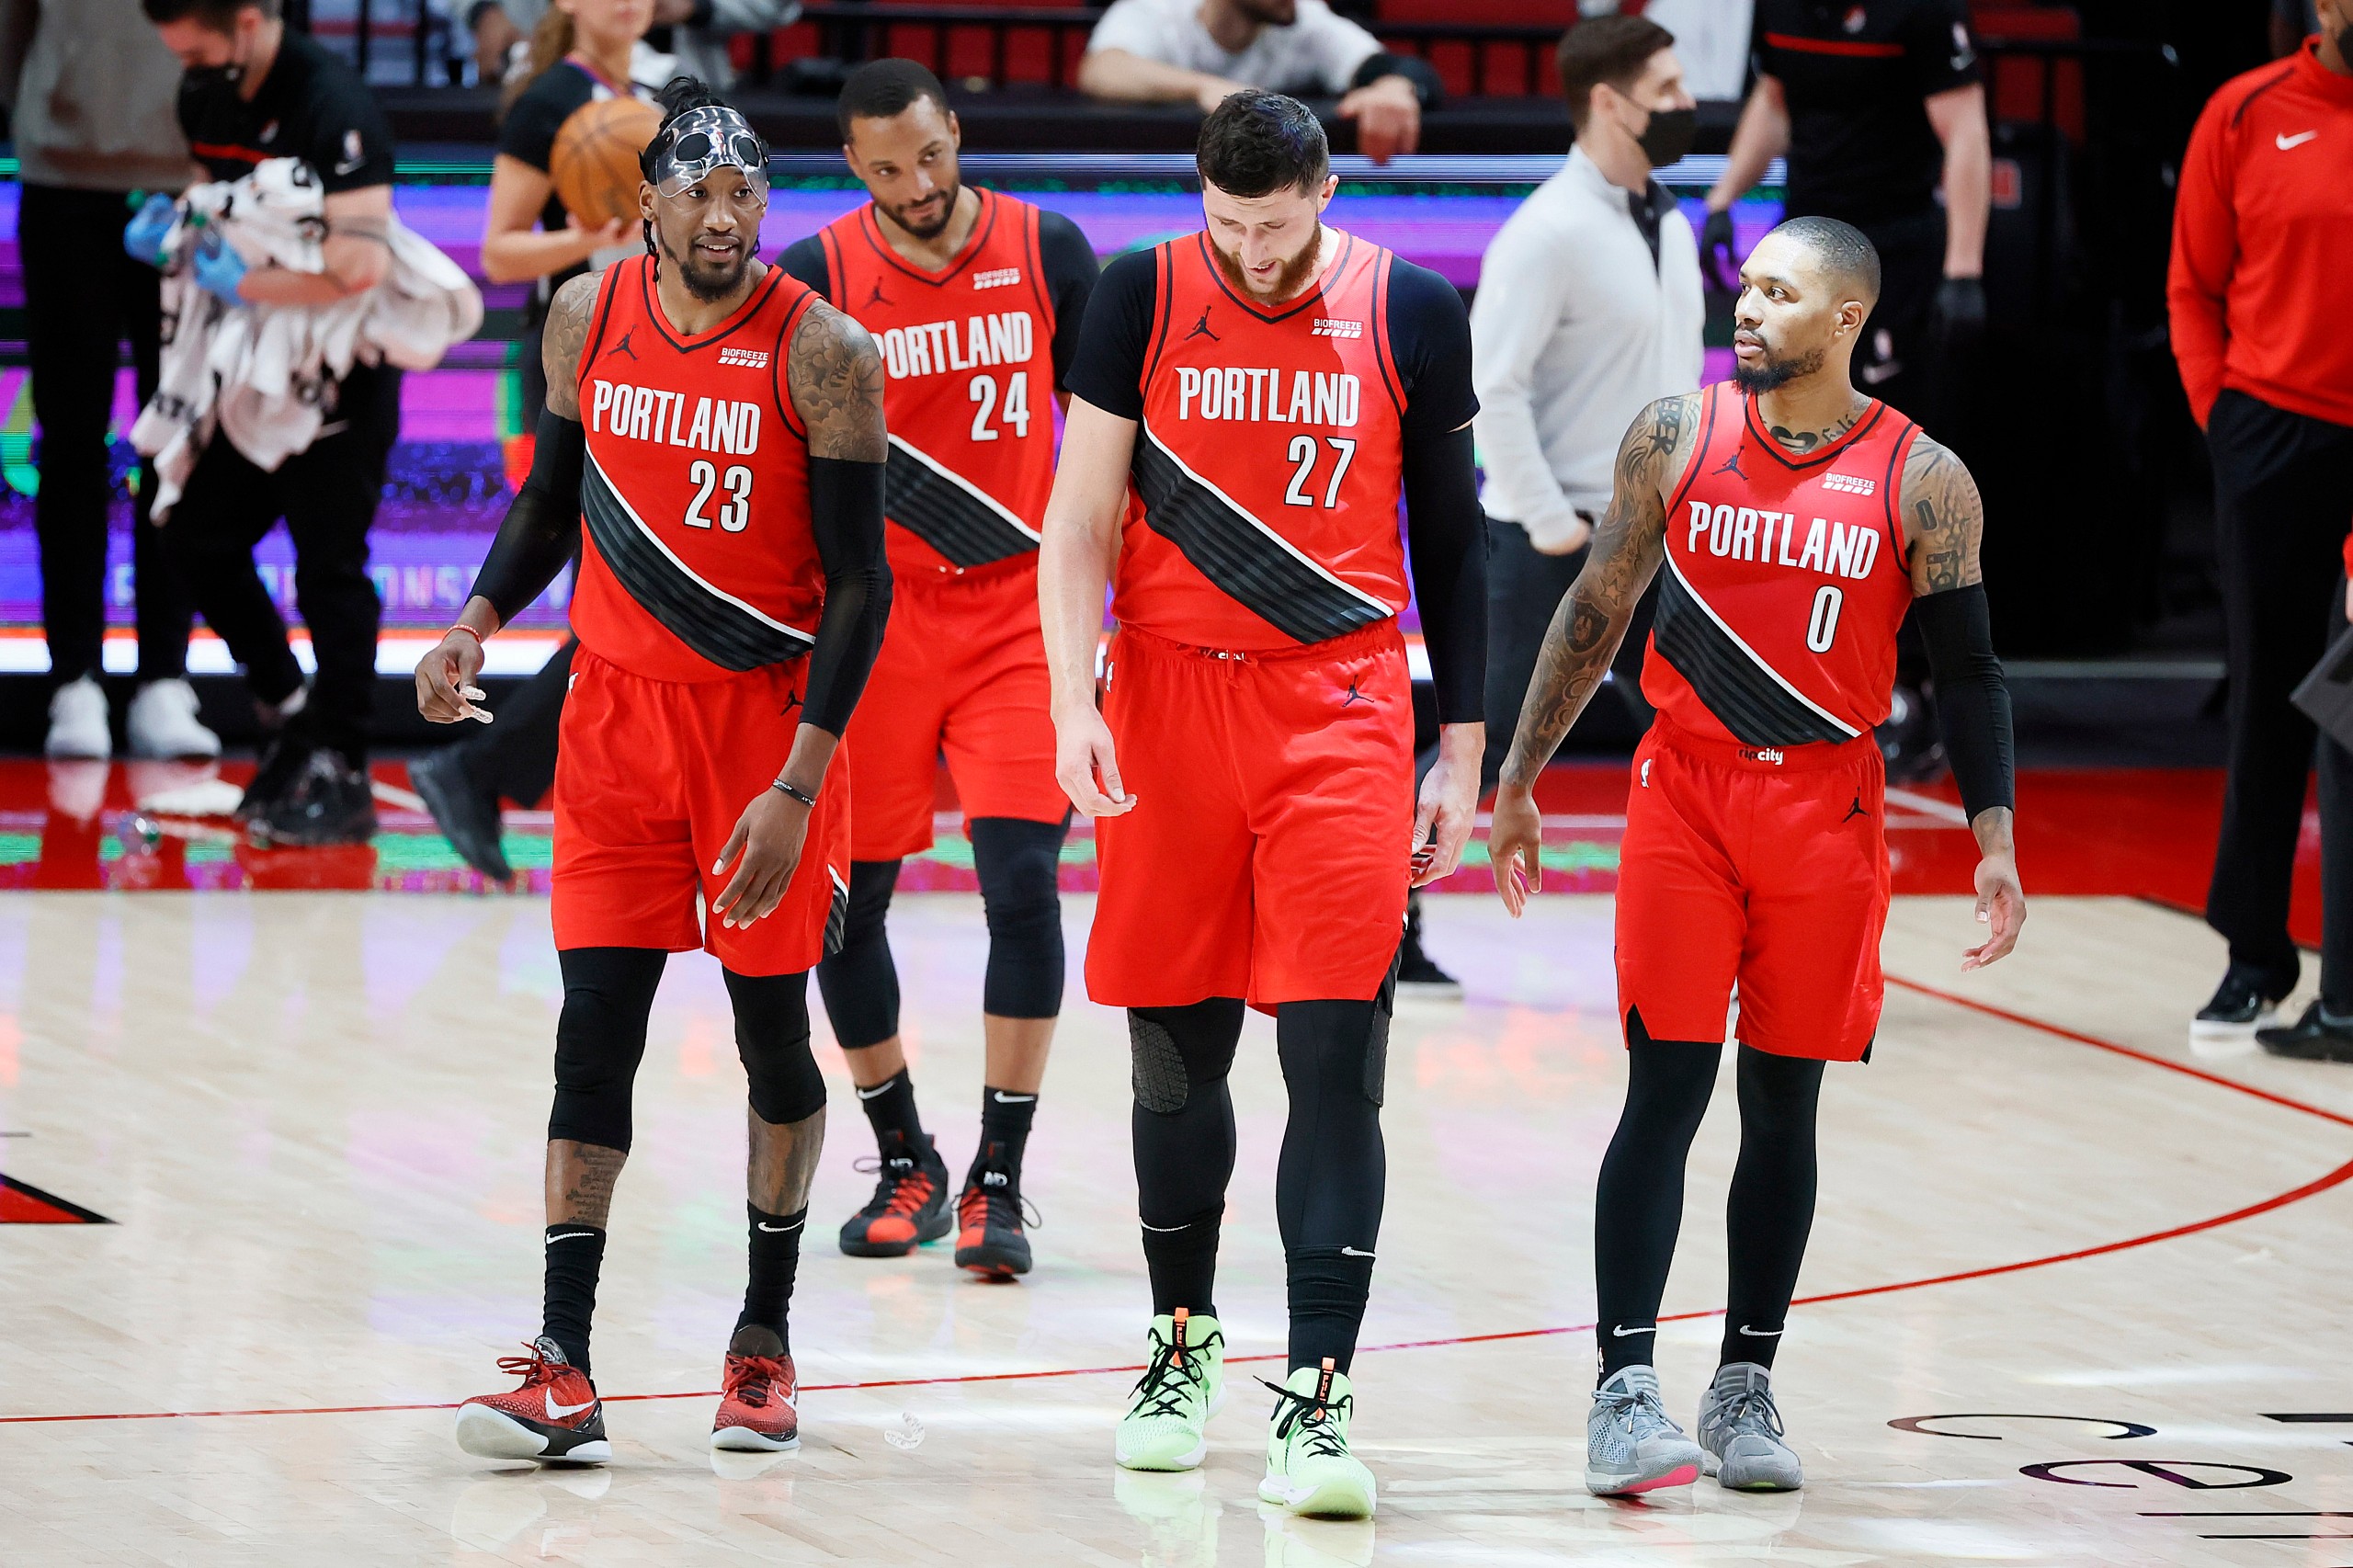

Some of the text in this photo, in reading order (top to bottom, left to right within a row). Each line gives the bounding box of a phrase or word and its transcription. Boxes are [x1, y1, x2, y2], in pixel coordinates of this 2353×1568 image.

[722, 347, 769, 361] BIOFREEZE
[1313, 318, 1362, 331] BIOFREEZE
[592, 379, 762, 456] PORTLAND
[969, 370, 1031, 442] 24
[1174, 367, 1361, 427] PORTLAND
[684, 459, 753, 533] 23
[1284, 435, 1358, 509] 27
[1824, 472, 1876, 490] BIOFREEZE
[1688, 500, 1881, 580] PORTLAND
[1806, 585, 1844, 653] 0
